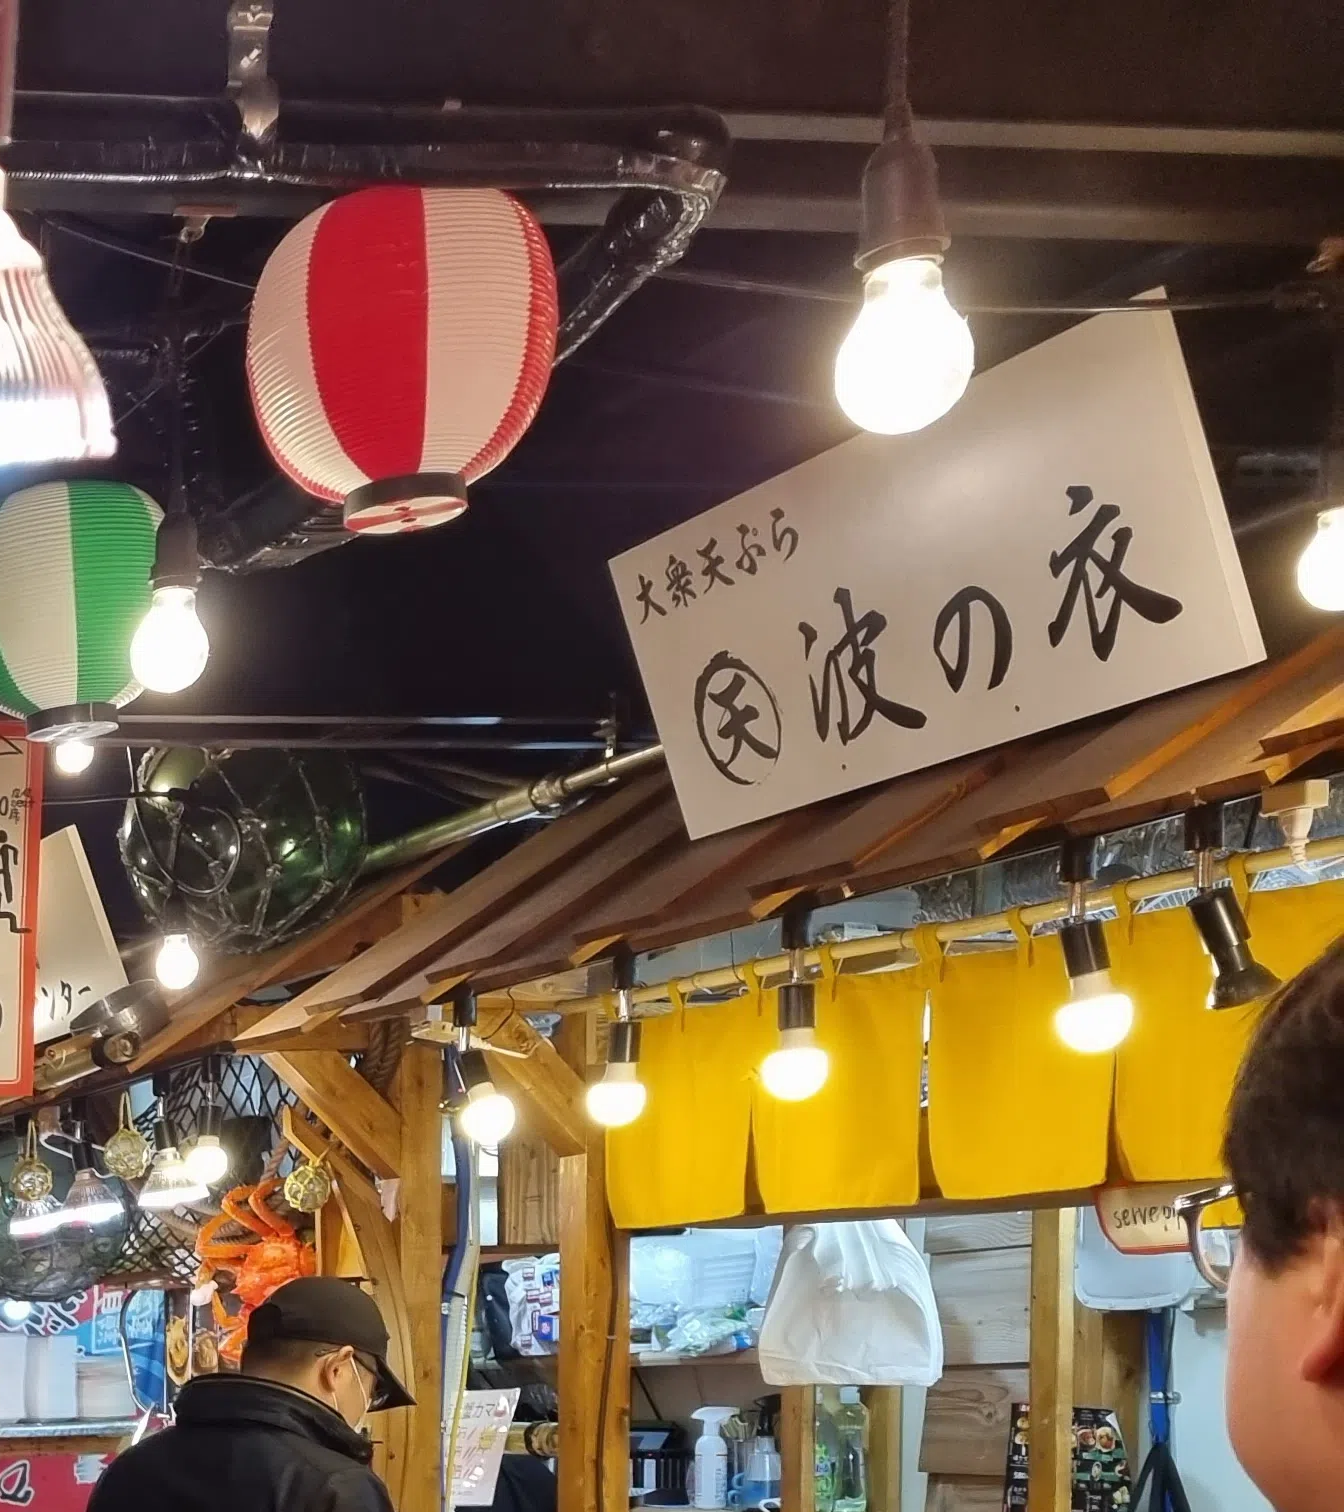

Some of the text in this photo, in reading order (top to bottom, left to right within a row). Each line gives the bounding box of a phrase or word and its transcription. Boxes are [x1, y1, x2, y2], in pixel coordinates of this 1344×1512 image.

[635, 508, 799, 624] 大衆天ぷら
[799, 485, 1182, 744] 波の衣
